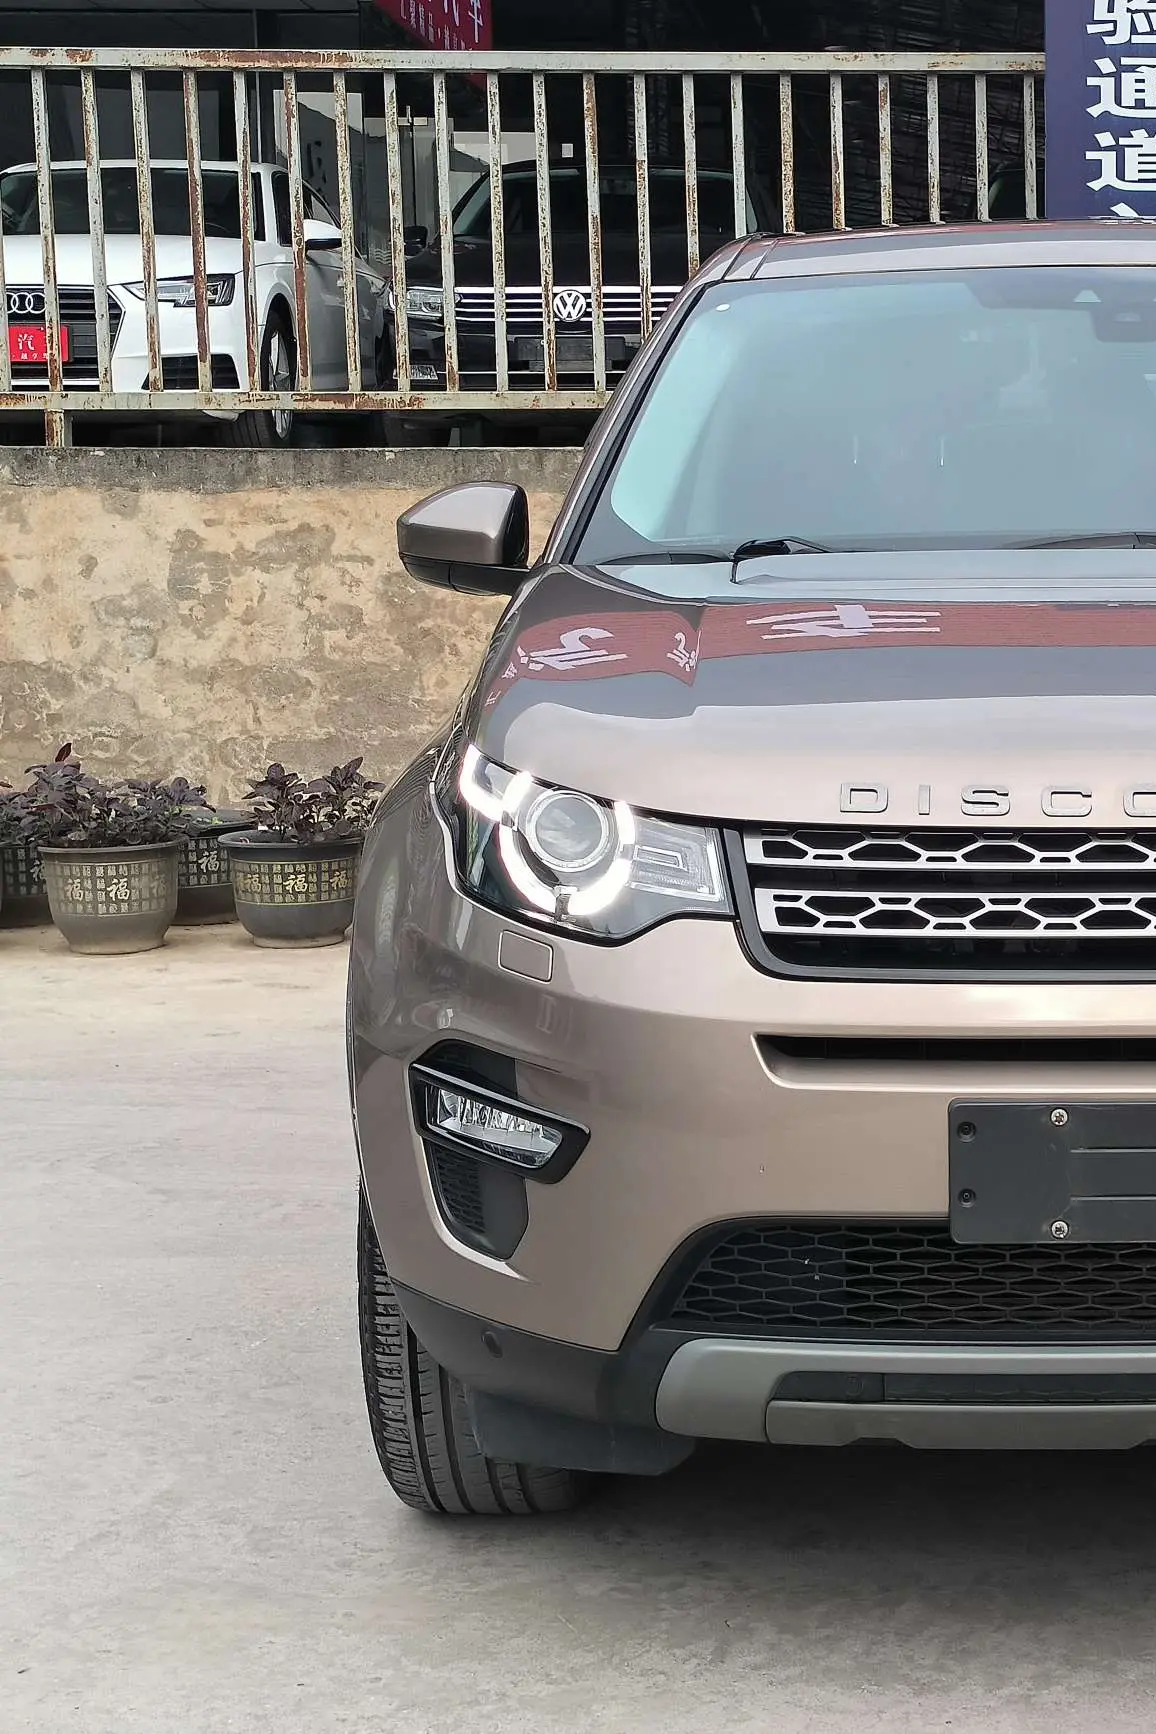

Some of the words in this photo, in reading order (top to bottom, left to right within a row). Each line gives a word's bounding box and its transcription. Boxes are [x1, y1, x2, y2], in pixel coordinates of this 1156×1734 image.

[198, 850, 221, 873] 福
[106, 877, 130, 901] 福
[283, 872, 308, 894] 福
